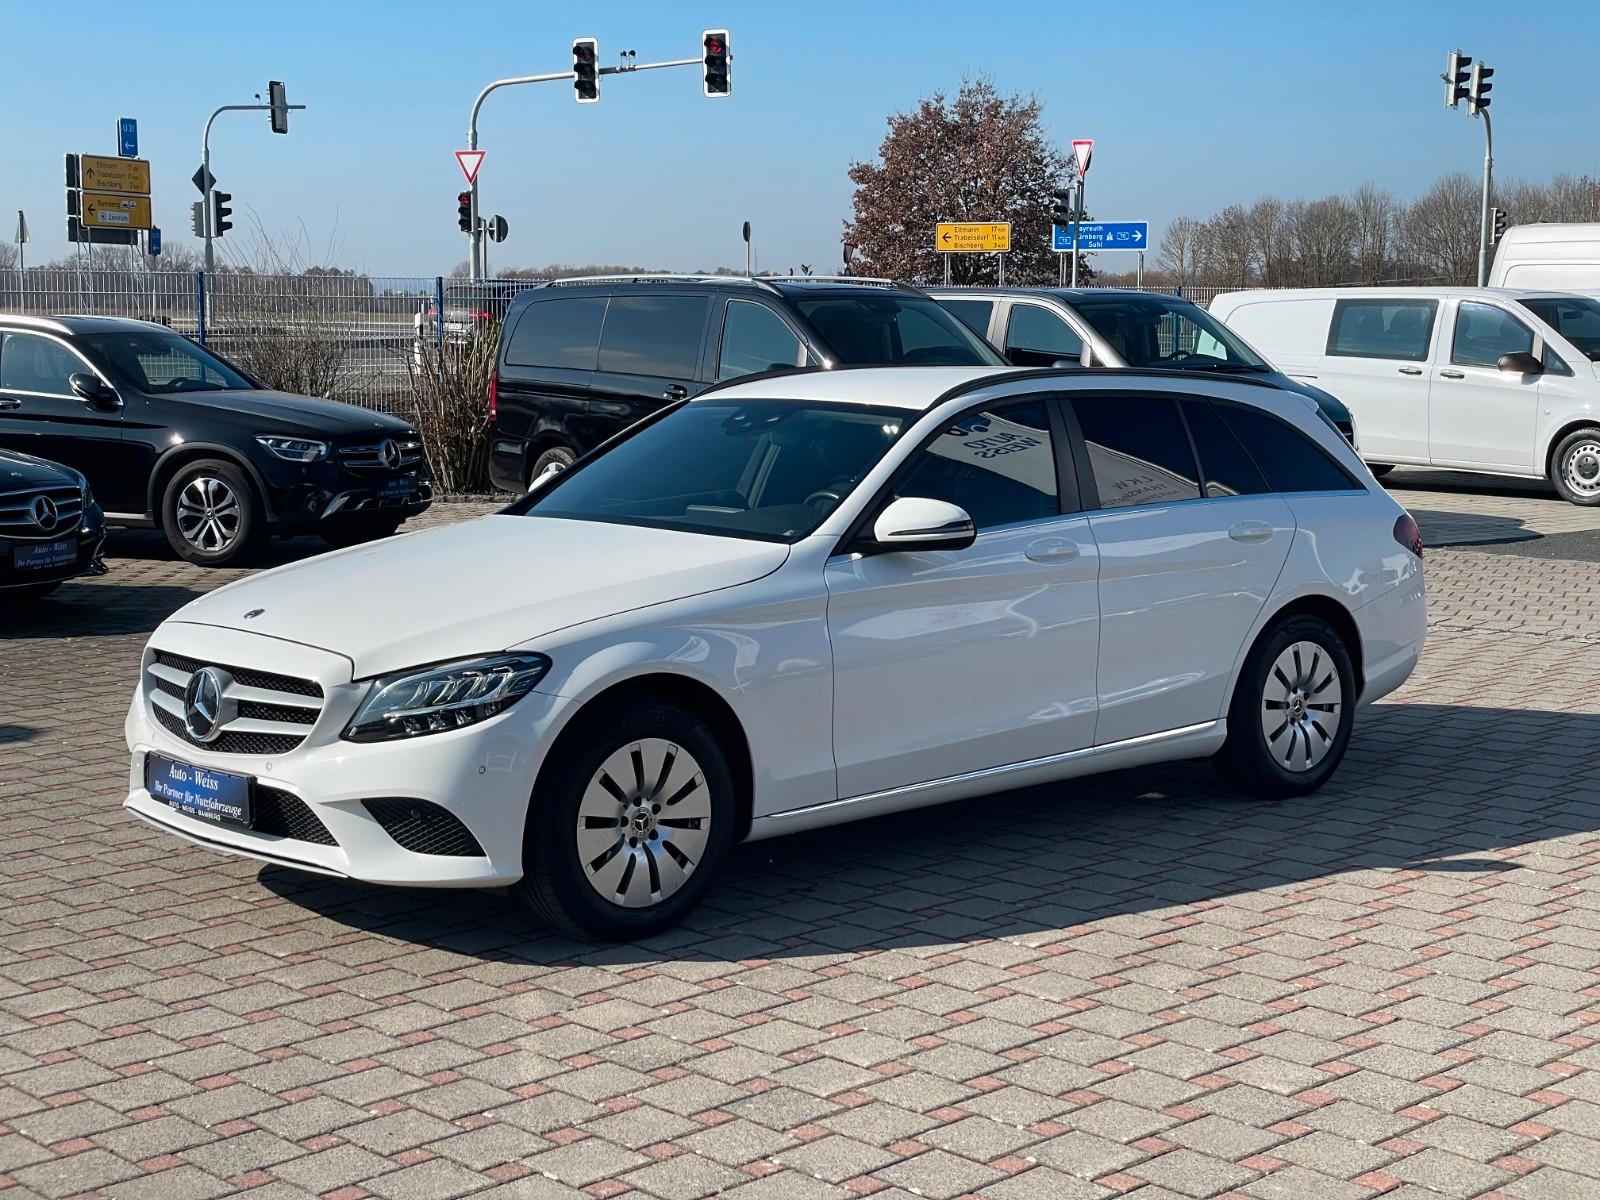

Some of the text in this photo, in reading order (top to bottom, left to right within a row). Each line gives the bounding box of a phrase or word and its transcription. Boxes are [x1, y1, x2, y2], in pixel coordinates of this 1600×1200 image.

[1078, 225, 1104, 233] ayreuth
[168, 763, 187, 782] Auto
[195, 770, 219, 791] Weiss
[154, 780, 242, 818] Ihr Partner für Nutzfahrzeuge
